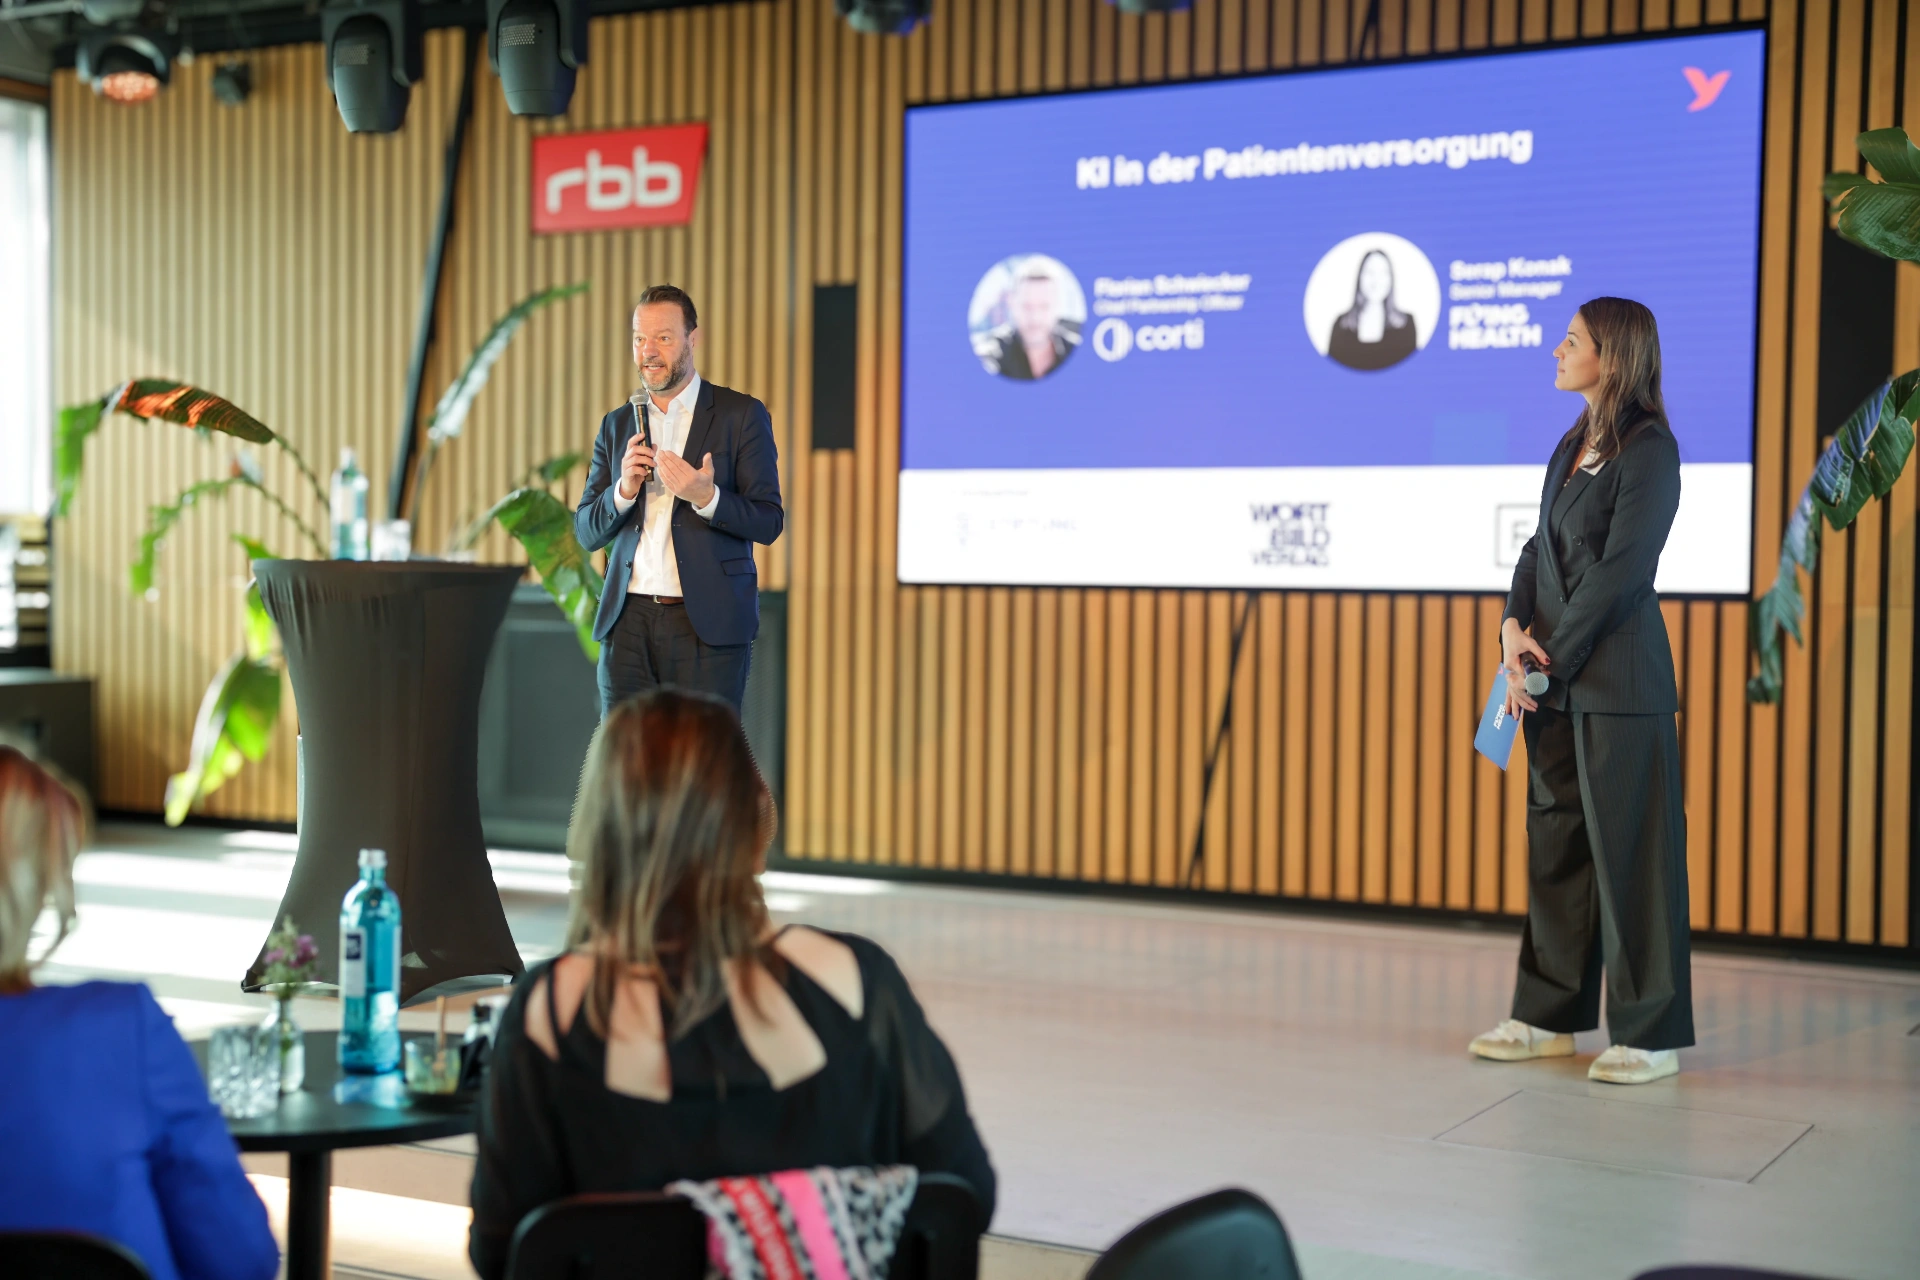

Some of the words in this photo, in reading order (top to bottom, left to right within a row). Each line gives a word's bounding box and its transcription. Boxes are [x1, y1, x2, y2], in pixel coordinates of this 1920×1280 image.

[1077, 157, 1110, 189] KI
[1113, 154, 1144, 187] in
[1147, 151, 1200, 184] der
[1203, 129, 1533, 181] Patientenversorgung
[545, 146, 682, 213] rbb
[1449, 303, 1529, 327] FLYING
[1136, 318, 1204, 351] corti
[1449, 324, 1542, 350] HEALTH
[1249, 502, 1330, 522] WORT
